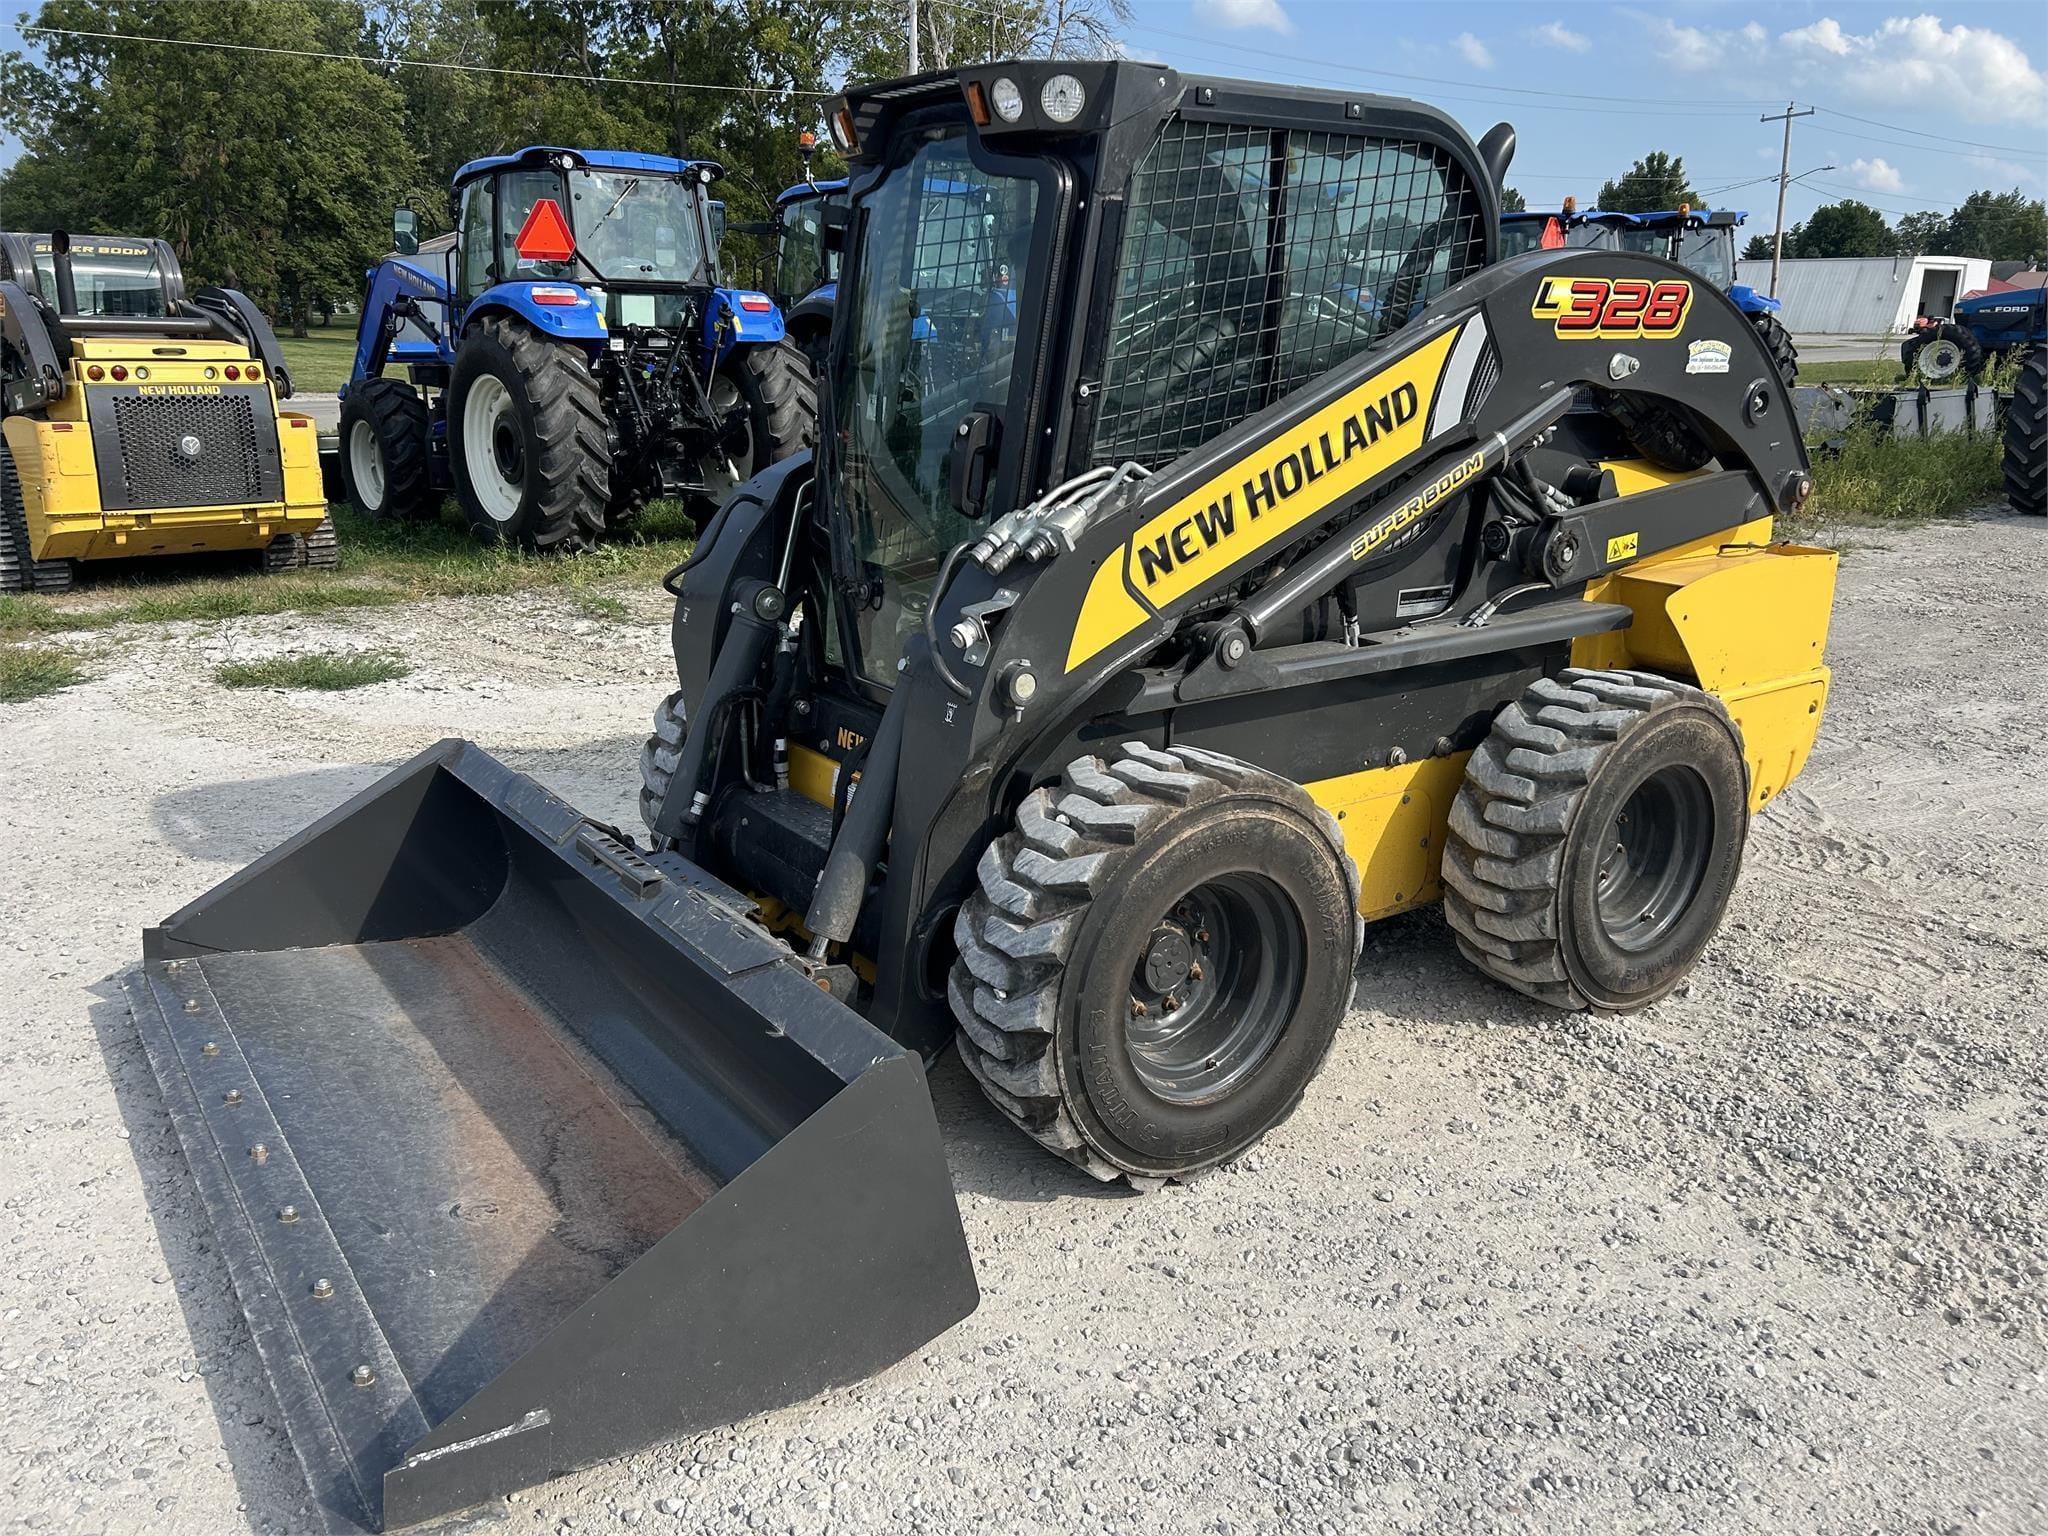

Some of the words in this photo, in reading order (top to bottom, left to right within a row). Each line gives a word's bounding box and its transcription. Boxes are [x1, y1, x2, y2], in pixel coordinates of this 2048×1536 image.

[35, 244, 95, 253] SER
[98, 246, 148, 256] BOOM
[1994, 305, 2030, 313] FORD
[138, 385, 166, 395] NEW
[168, 385, 220, 395] HOLLAND
[1137, 492, 1236, 588] NEW
[1242, 380, 1419, 521] HOLLAND
[1351, 496, 1424, 561] SUPER
[1423, 451, 1484, 509] BOOM
